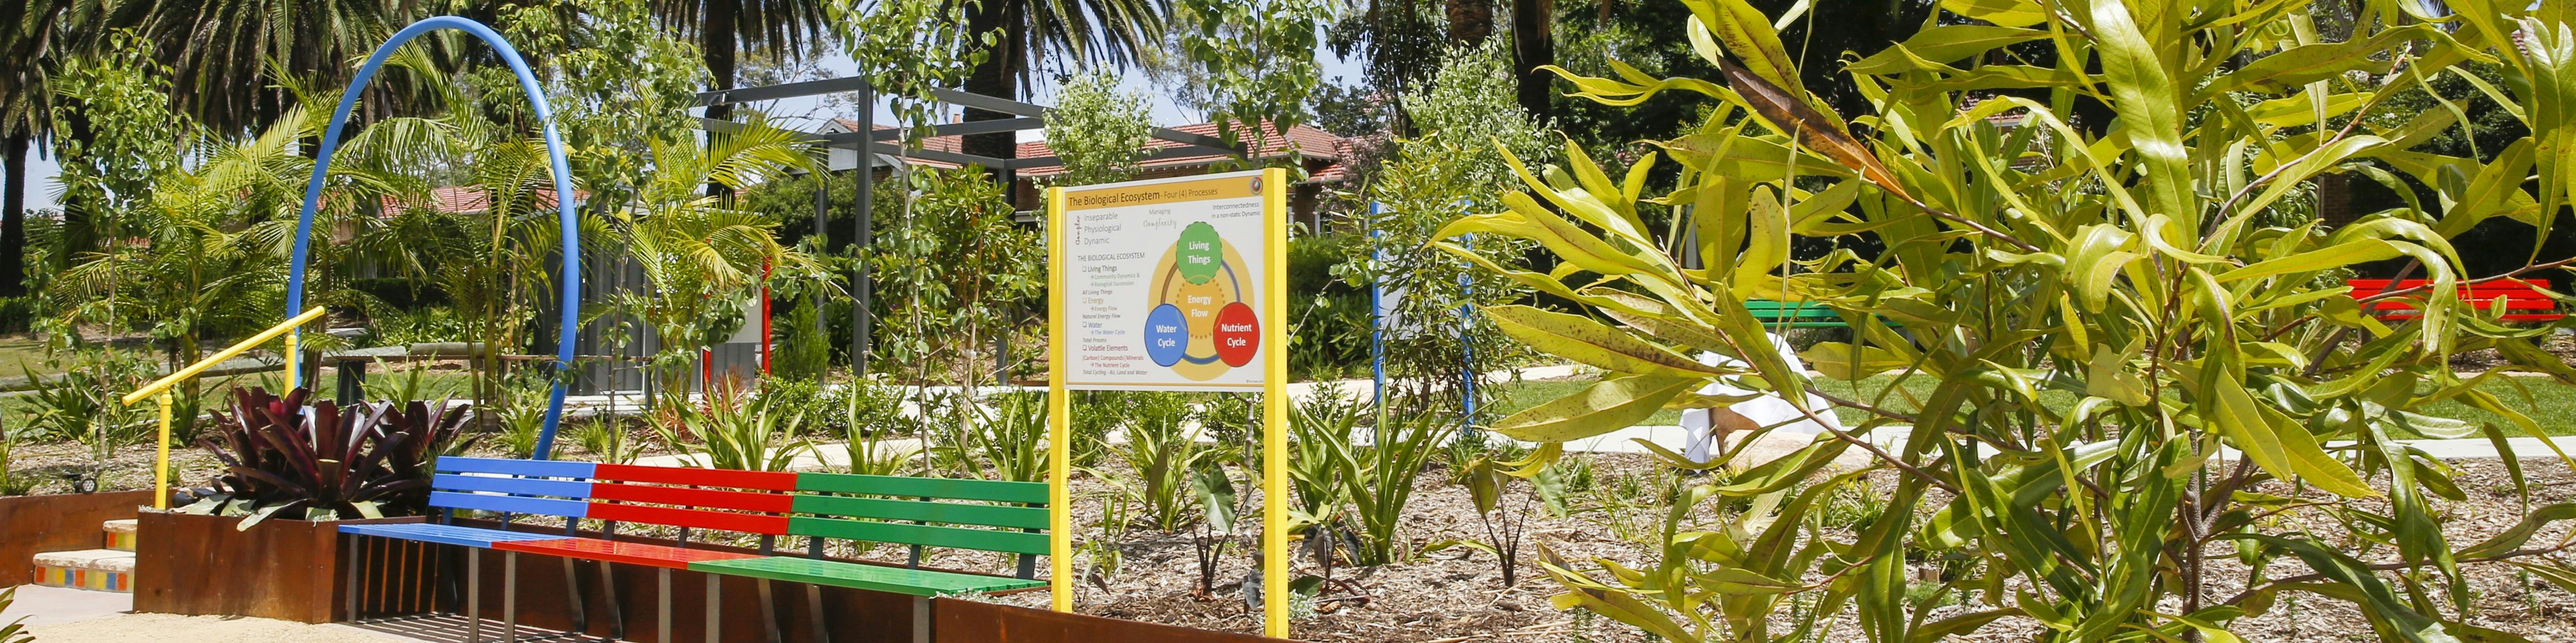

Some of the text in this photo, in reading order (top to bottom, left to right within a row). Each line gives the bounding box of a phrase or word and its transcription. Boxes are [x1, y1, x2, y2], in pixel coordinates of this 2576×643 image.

[1069, 197, 1081, 206] The
[1084, 193, 1118, 206] Biological
[1179, 190, 1187, 199] (4)
[1189, 188, 1218, 197] Processes
[1213, 201, 1259, 210] Interconnectedness
[1084, 212, 1118, 222] Inseparable
[1084, 224, 1121, 234] Physiological
[1143, 218, 1177, 230] Complexity
[1084, 238, 1110, 246] Dynamic
[1189, 241, 1209, 251] Living
[1188, 256, 1211, 265] Things
[1188, 295, 1211, 305] Energy
[1156, 325, 1177, 333] Water
[1222, 324, 1252, 332] Nutrient
[1158, 338, 1176, 348] Cycle
[1227, 337, 1246, 348] Cycle
